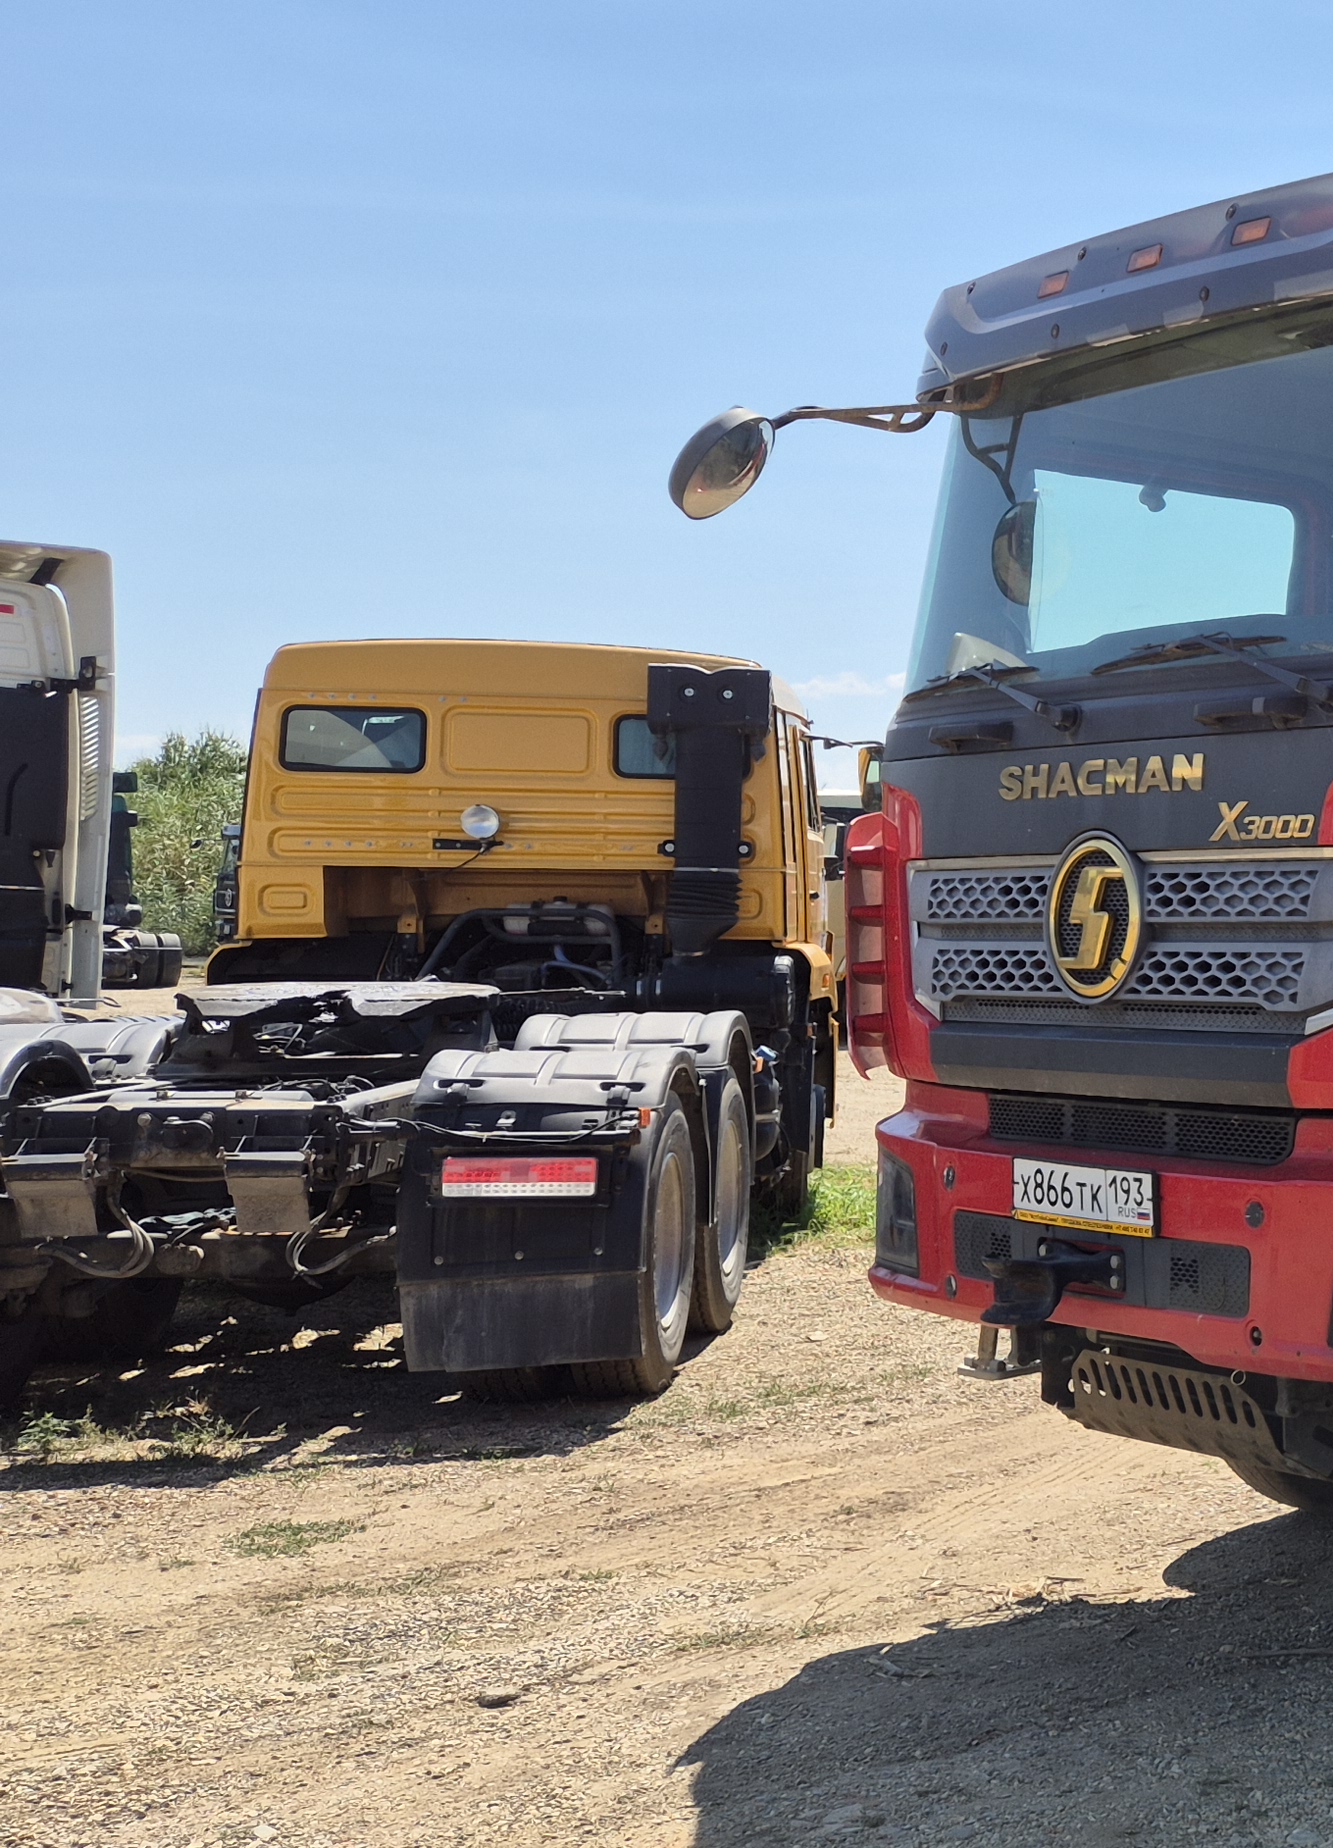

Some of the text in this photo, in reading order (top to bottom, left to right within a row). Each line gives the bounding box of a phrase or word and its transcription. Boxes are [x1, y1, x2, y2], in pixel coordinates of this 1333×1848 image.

[998, 752, 1205, 801] SHACMAN
[1209, 801, 1315, 842] X3000
[1108, 1175, 1144, 1207] 193
[1117, 1206, 1137, 1219] RUS
